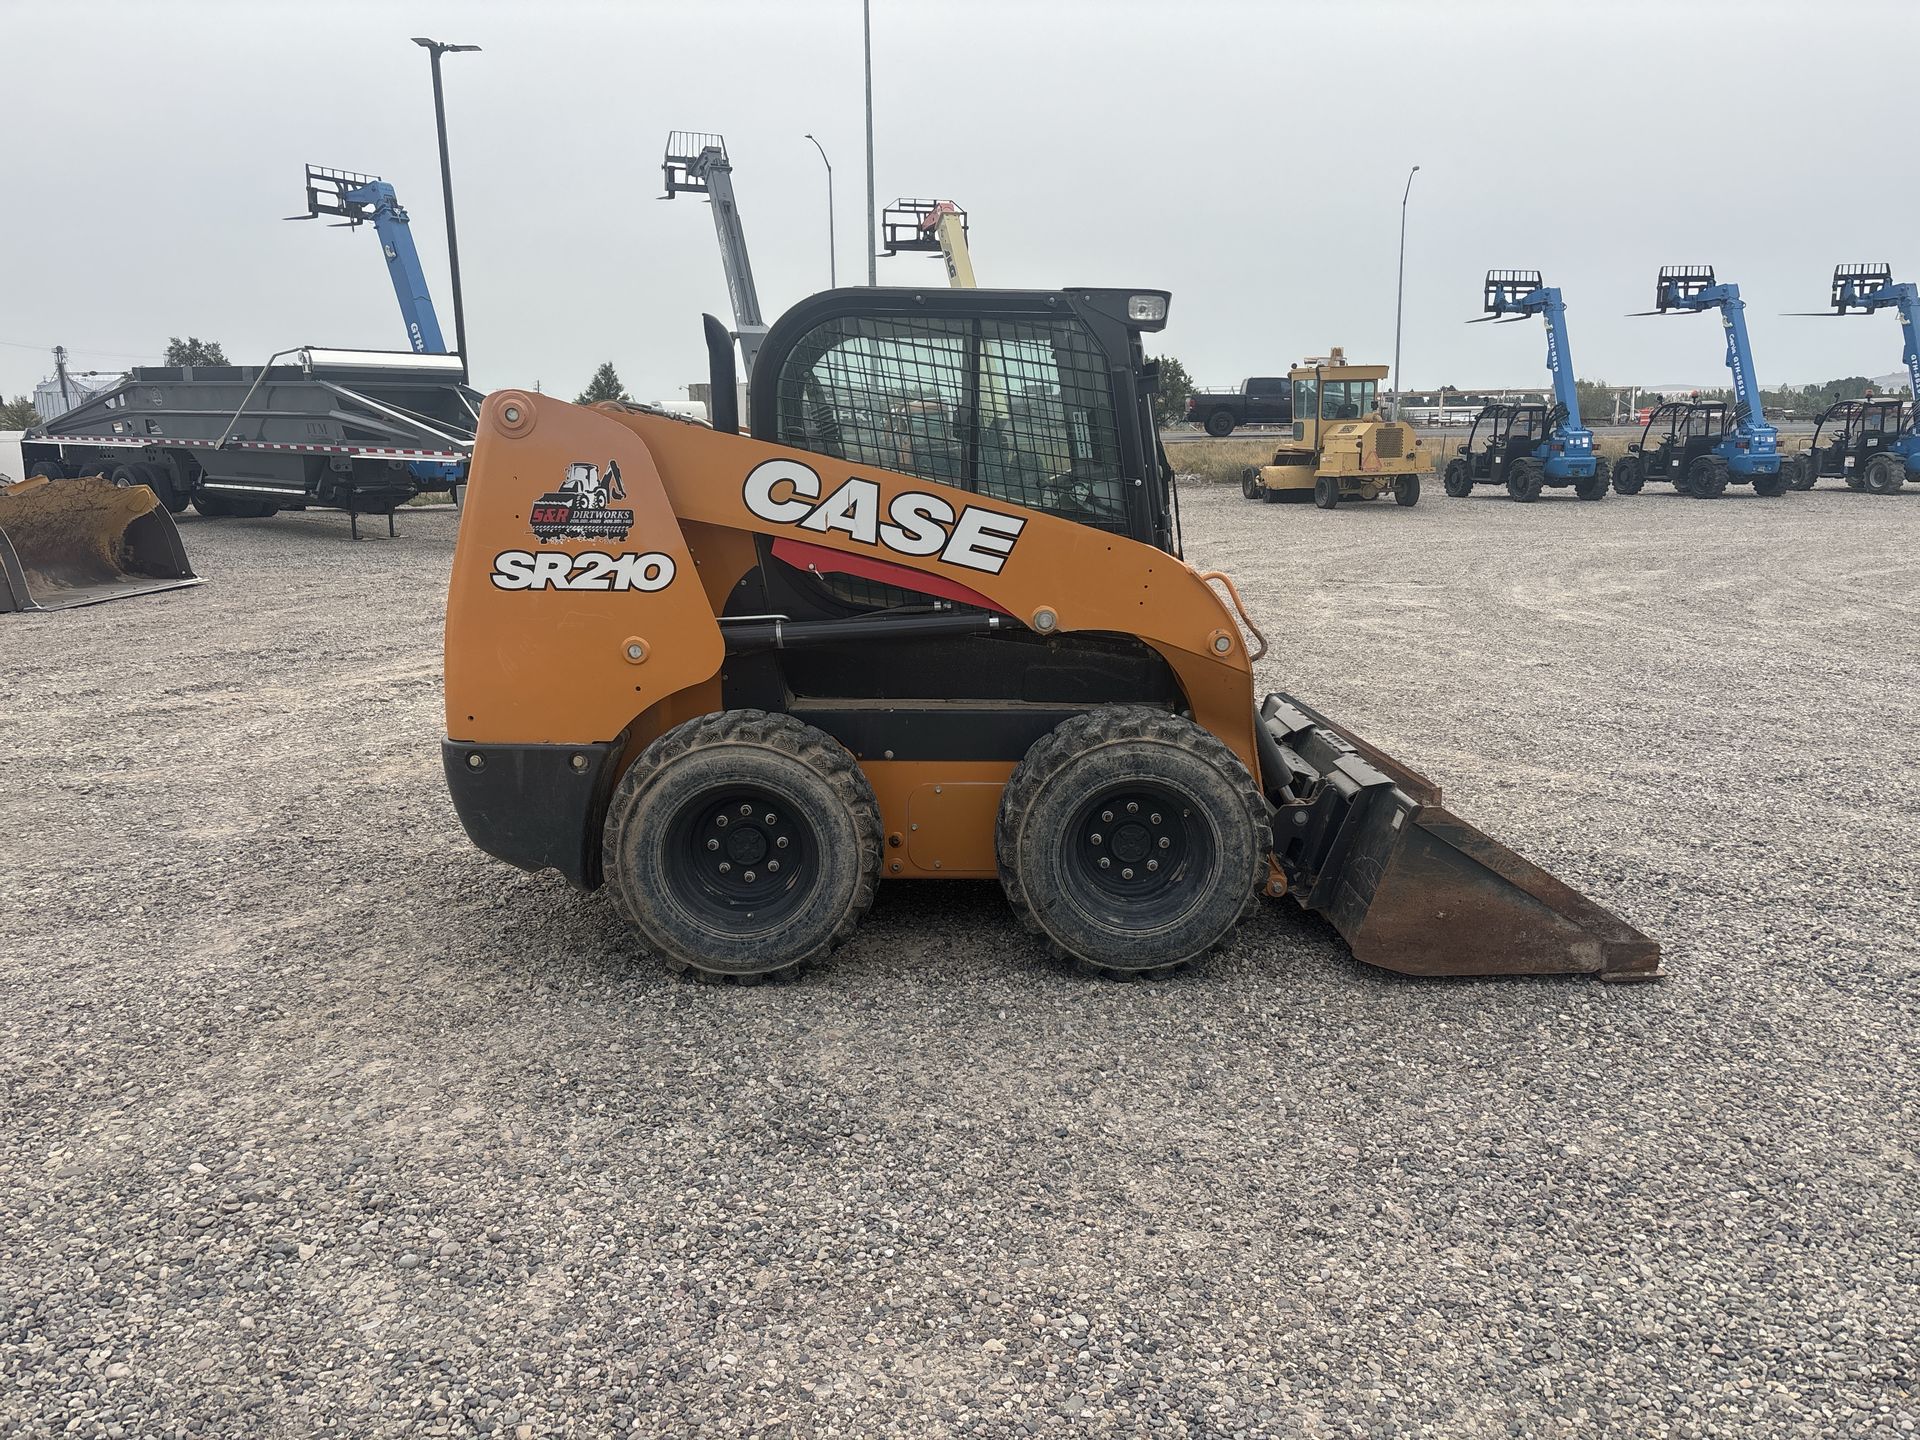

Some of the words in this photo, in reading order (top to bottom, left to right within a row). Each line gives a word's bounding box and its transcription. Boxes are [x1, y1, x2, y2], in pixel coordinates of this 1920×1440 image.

[532, 508, 569, 523] S&R
[572, 511, 630, 519] DIRTWORKS
[742, 458, 1027, 574] CASE
[490, 550, 676, 592] SR210
